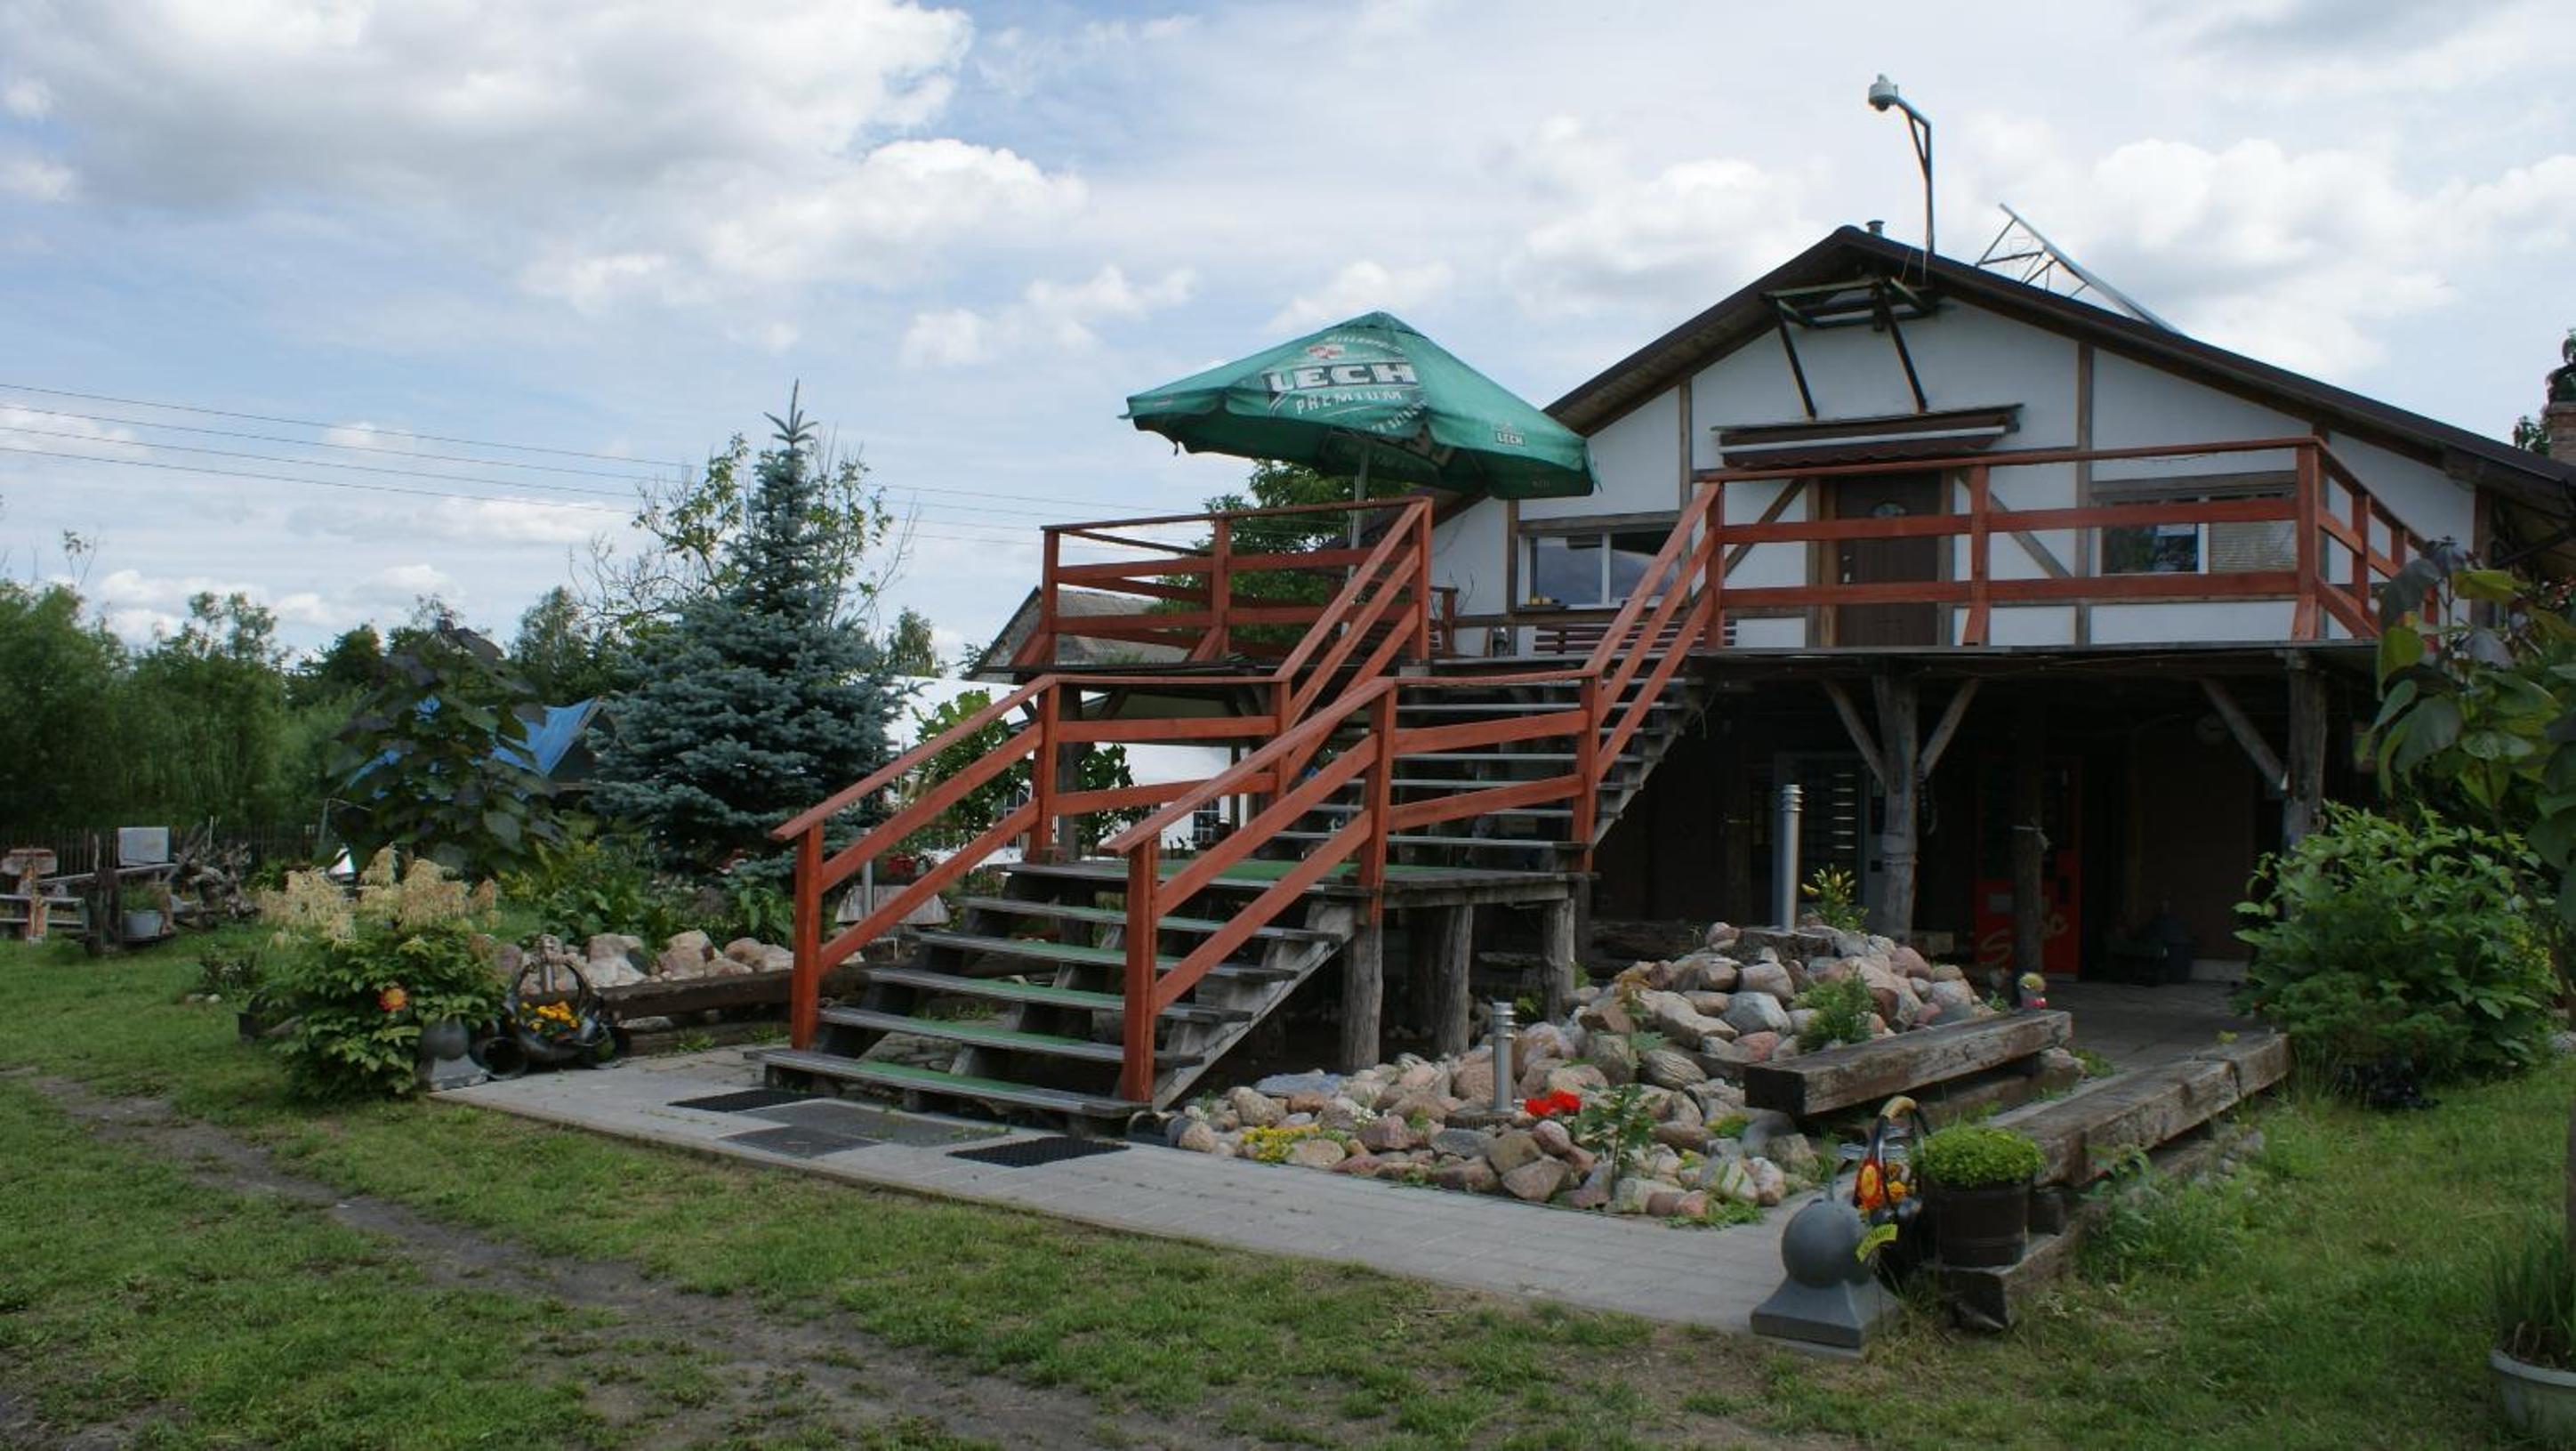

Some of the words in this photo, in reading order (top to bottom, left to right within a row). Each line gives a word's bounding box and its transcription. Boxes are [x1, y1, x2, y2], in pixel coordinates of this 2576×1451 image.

[1263, 363, 1418, 392] LECH
[1295, 390, 1402, 415] PREMIUM
[1496, 431, 1524, 446] LECH
